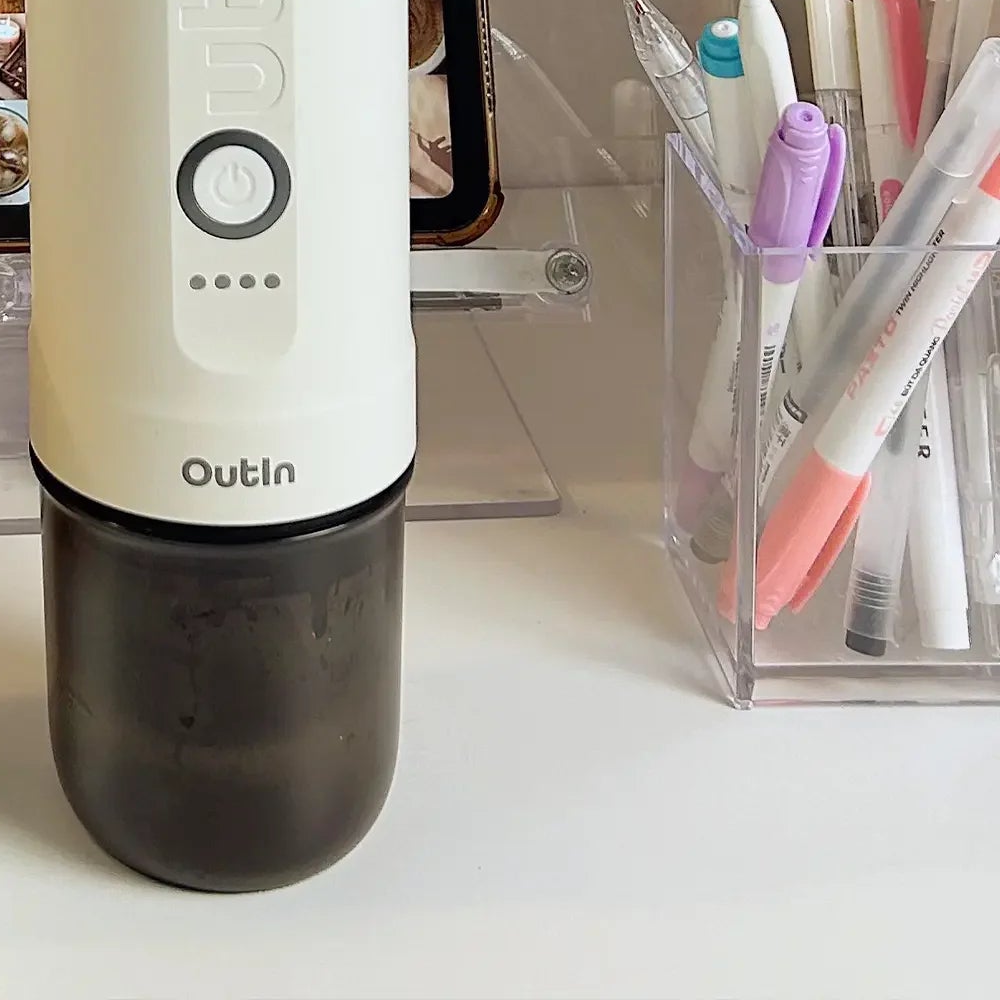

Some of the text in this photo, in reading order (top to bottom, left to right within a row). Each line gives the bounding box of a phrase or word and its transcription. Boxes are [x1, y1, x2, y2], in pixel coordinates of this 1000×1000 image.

[895, 289, 913, 317] TWIN
[918, 335, 941, 367] QUANG
[181, 456, 296, 488] OutIn
